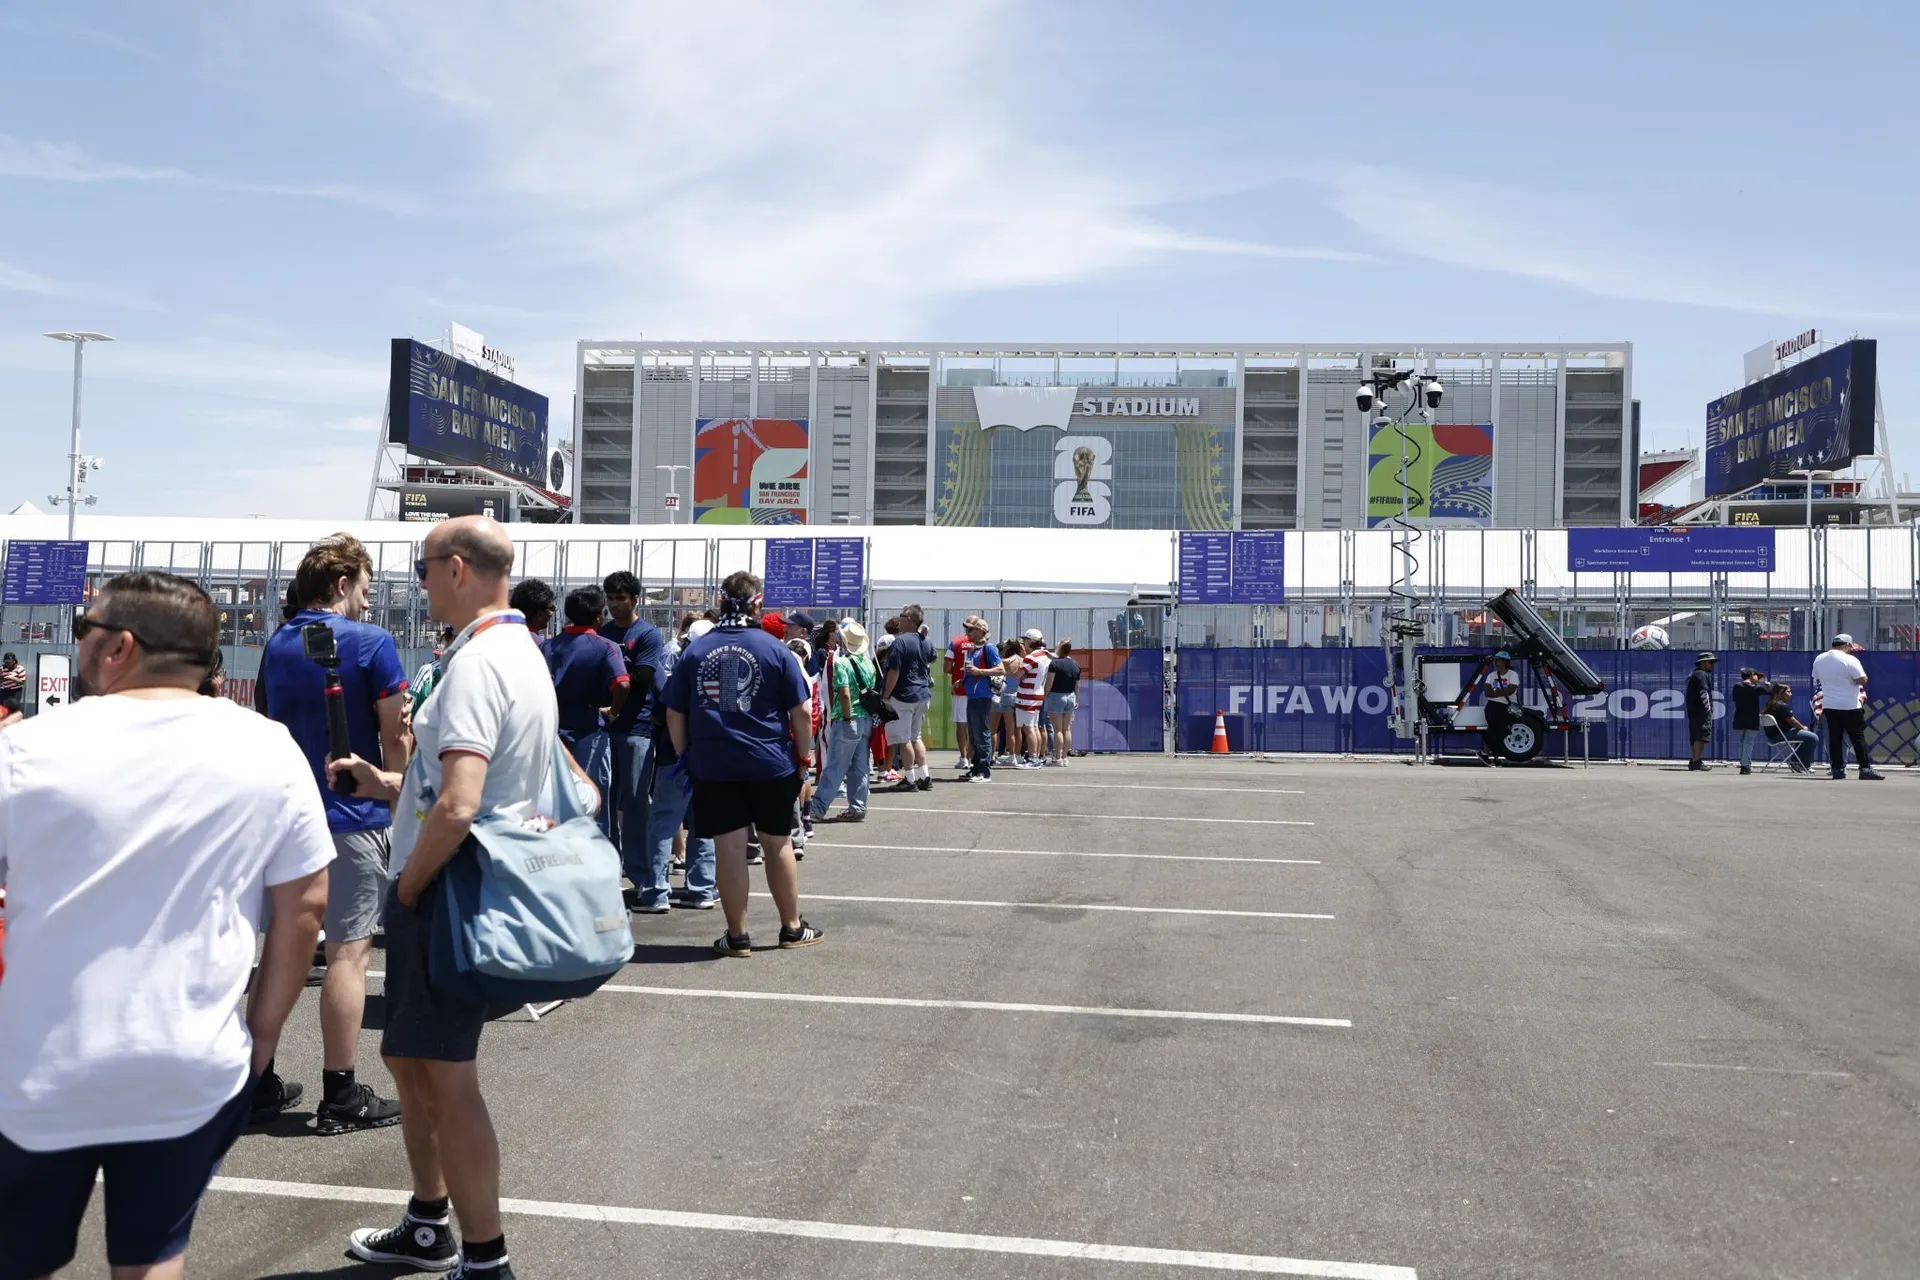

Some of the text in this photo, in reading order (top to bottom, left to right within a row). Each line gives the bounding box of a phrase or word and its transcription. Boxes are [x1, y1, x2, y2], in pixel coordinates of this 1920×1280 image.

[1773, 329, 1816, 360] STADIUM
[482, 345, 516, 370] STADIUM
[428, 372, 536, 433] SAN FRANCISCO
[1082, 397, 1200, 416] STADIUM
[1718, 377, 1832, 442] SAN FRANCISCO
[452, 409, 516, 452] BAY AREA
[1738, 419, 1805, 464] BAY AREA
[405, 494, 426, 502] FIFA
[759, 482, 776, 490] WE
[1070, 507, 1095, 516] FIFA
[1735, 513, 1760, 521] FIFA
[706, 646, 729, 660] MEN'S
[731, 646, 759, 672] NATIONAL
[41, 677, 68, 692] EXIT
[1230, 686, 1314, 714] FIFA
